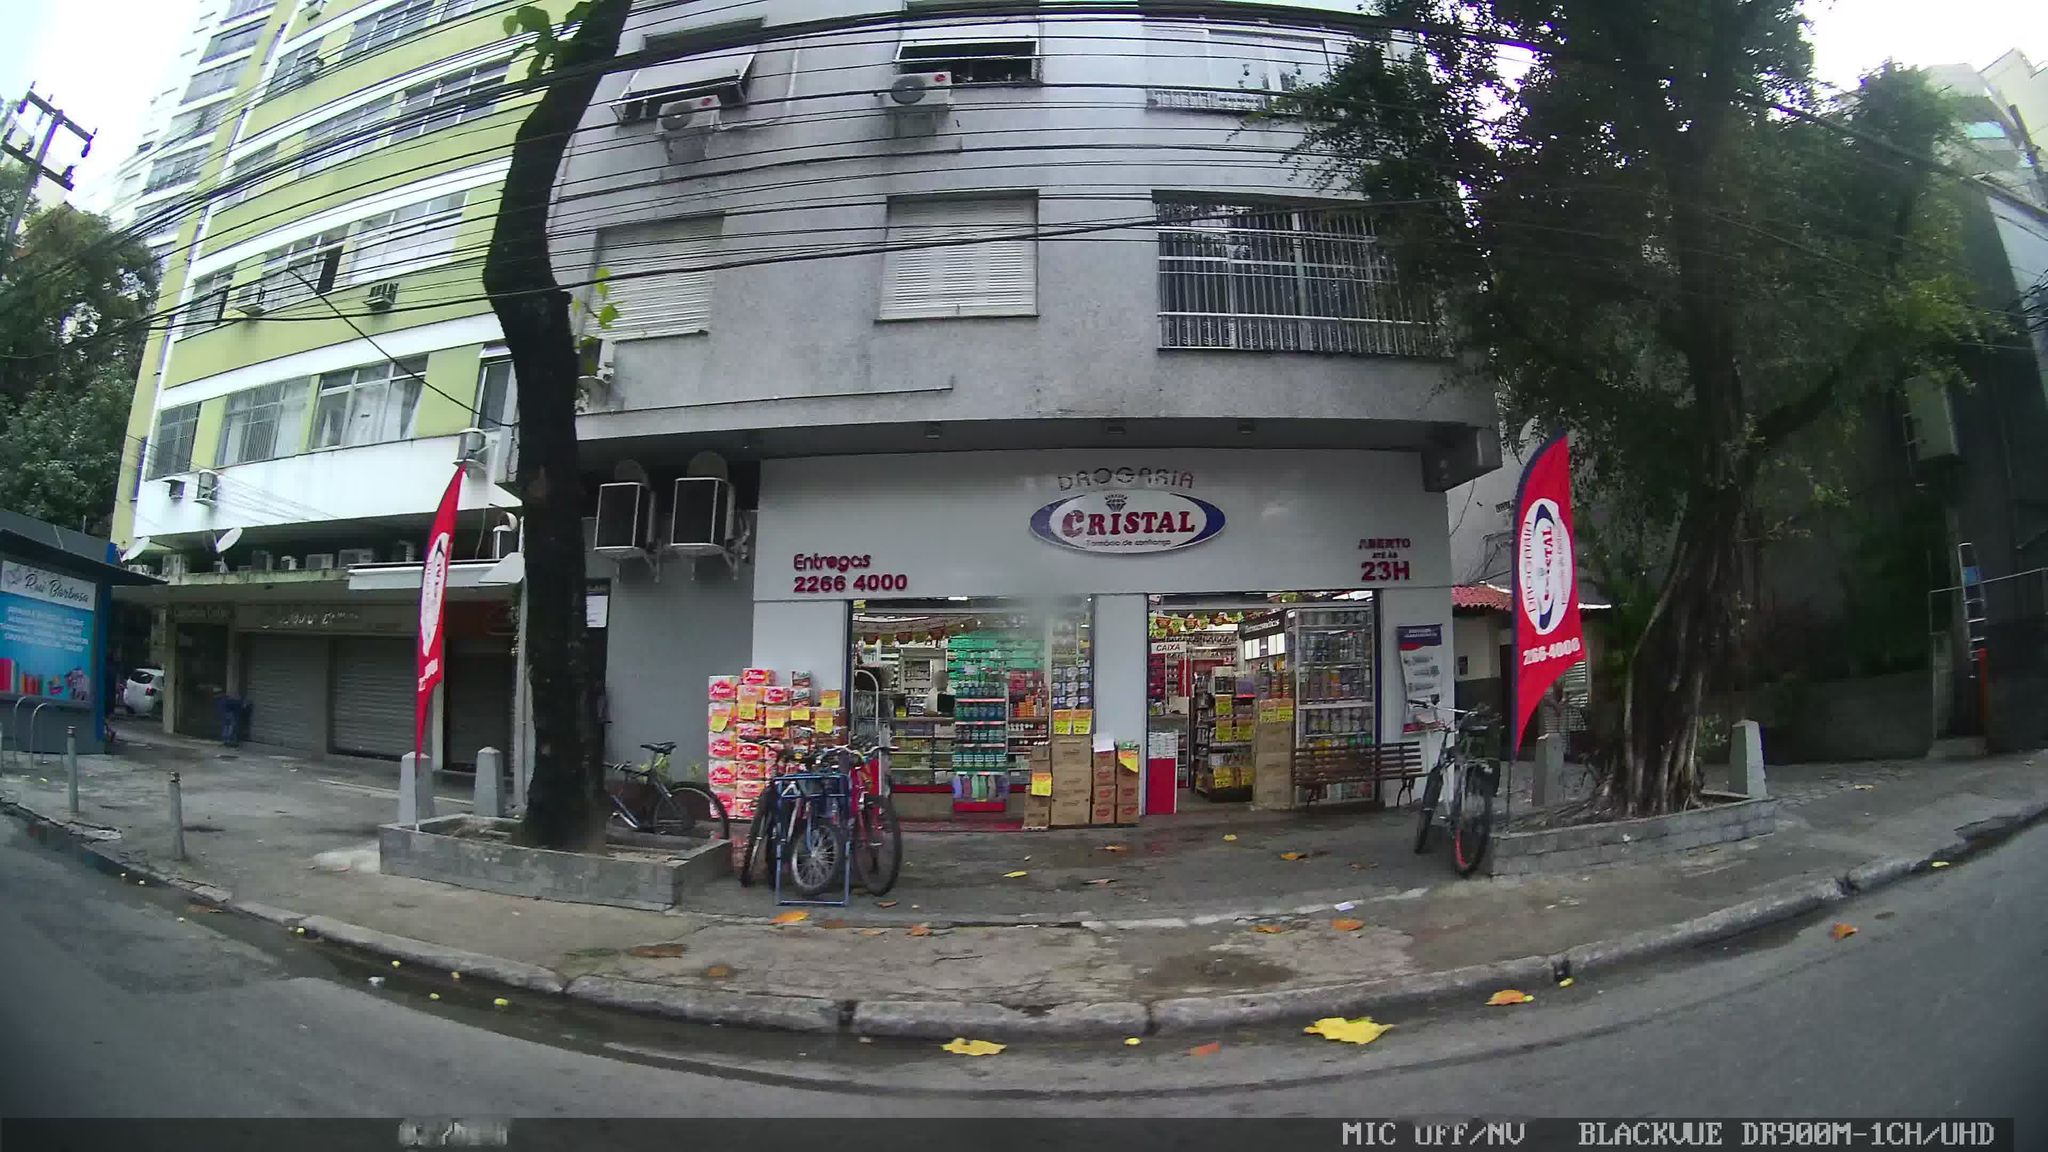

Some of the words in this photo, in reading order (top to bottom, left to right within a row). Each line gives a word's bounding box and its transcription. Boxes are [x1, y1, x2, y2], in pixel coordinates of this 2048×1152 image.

[1061, 509, 1196, 538] CRISTAL
[793, 553, 872, 573] Entregas
[1360, 560, 1410, 581] 23H
[793, 575, 847, 594] 2266
[852, 573, 908, 592] 4000
[1155, 643, 1181, 652] CAIXA
